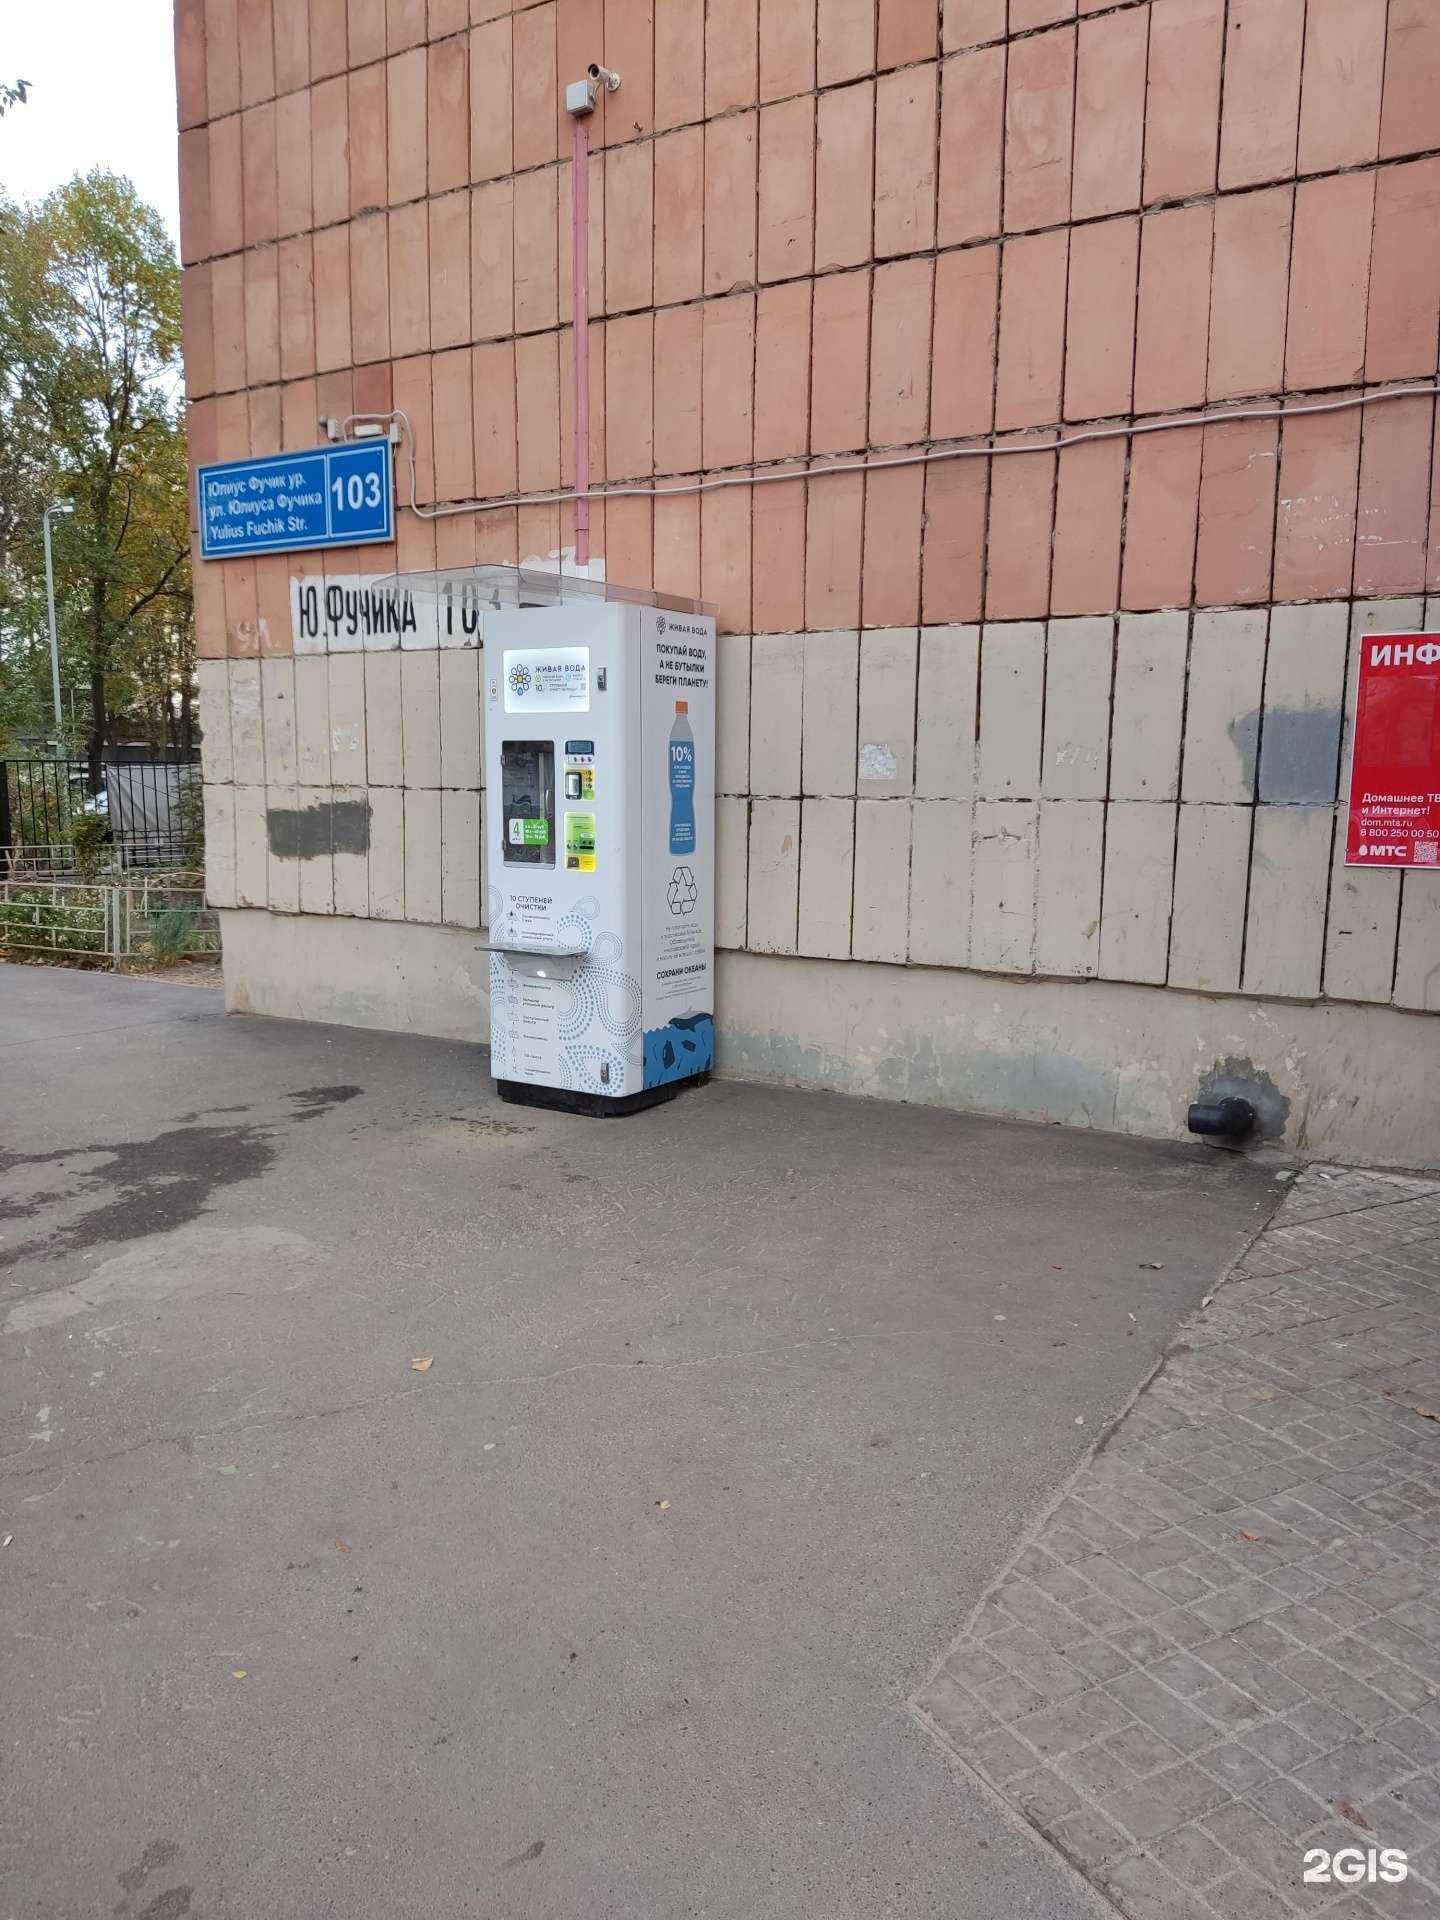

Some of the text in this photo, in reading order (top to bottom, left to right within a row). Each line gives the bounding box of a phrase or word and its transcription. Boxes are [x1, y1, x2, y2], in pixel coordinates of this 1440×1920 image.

[208, 473, 306, 498] Юлиус Фучик ур.
[332, 472, 381, 511] 103
[209, 492, 322, 521] ул. Юлиуса Фучика
[210, 516, 308, 540] Yulius Fuchik Str.
[669, 623, 707, 636] ЖИВАЯ ВОДА
[656, 643, 706, 660] ПОКУПАЙ ВОДУ,
[535, 664, 586, 673] ЖИВАЯ ВОДА
[660, 660, 704, 674] А НЕ БУТЫЛКИ
[656, 674, 709, 688] БЕРЕГИ ПЛАНЕТУ!
[671, 746, 692, 762] 10%
[1362, 793, 1440, 804] Домашнее ТВ
[1361, 805, 1430, 816] и Интернет!
[1361, 818, 1413, 827] dom.mts.ru
[1360, 828, 1439, 839] 8 800 250 00 50
[1370, 845, 1407, 857] МТС
[518, 895, 553, 904] СТУПЕНЕЙ
[515, 902, 547, 911] ОЧИСТКИ
[656, 967, 683, 980] СОХРАНИ
